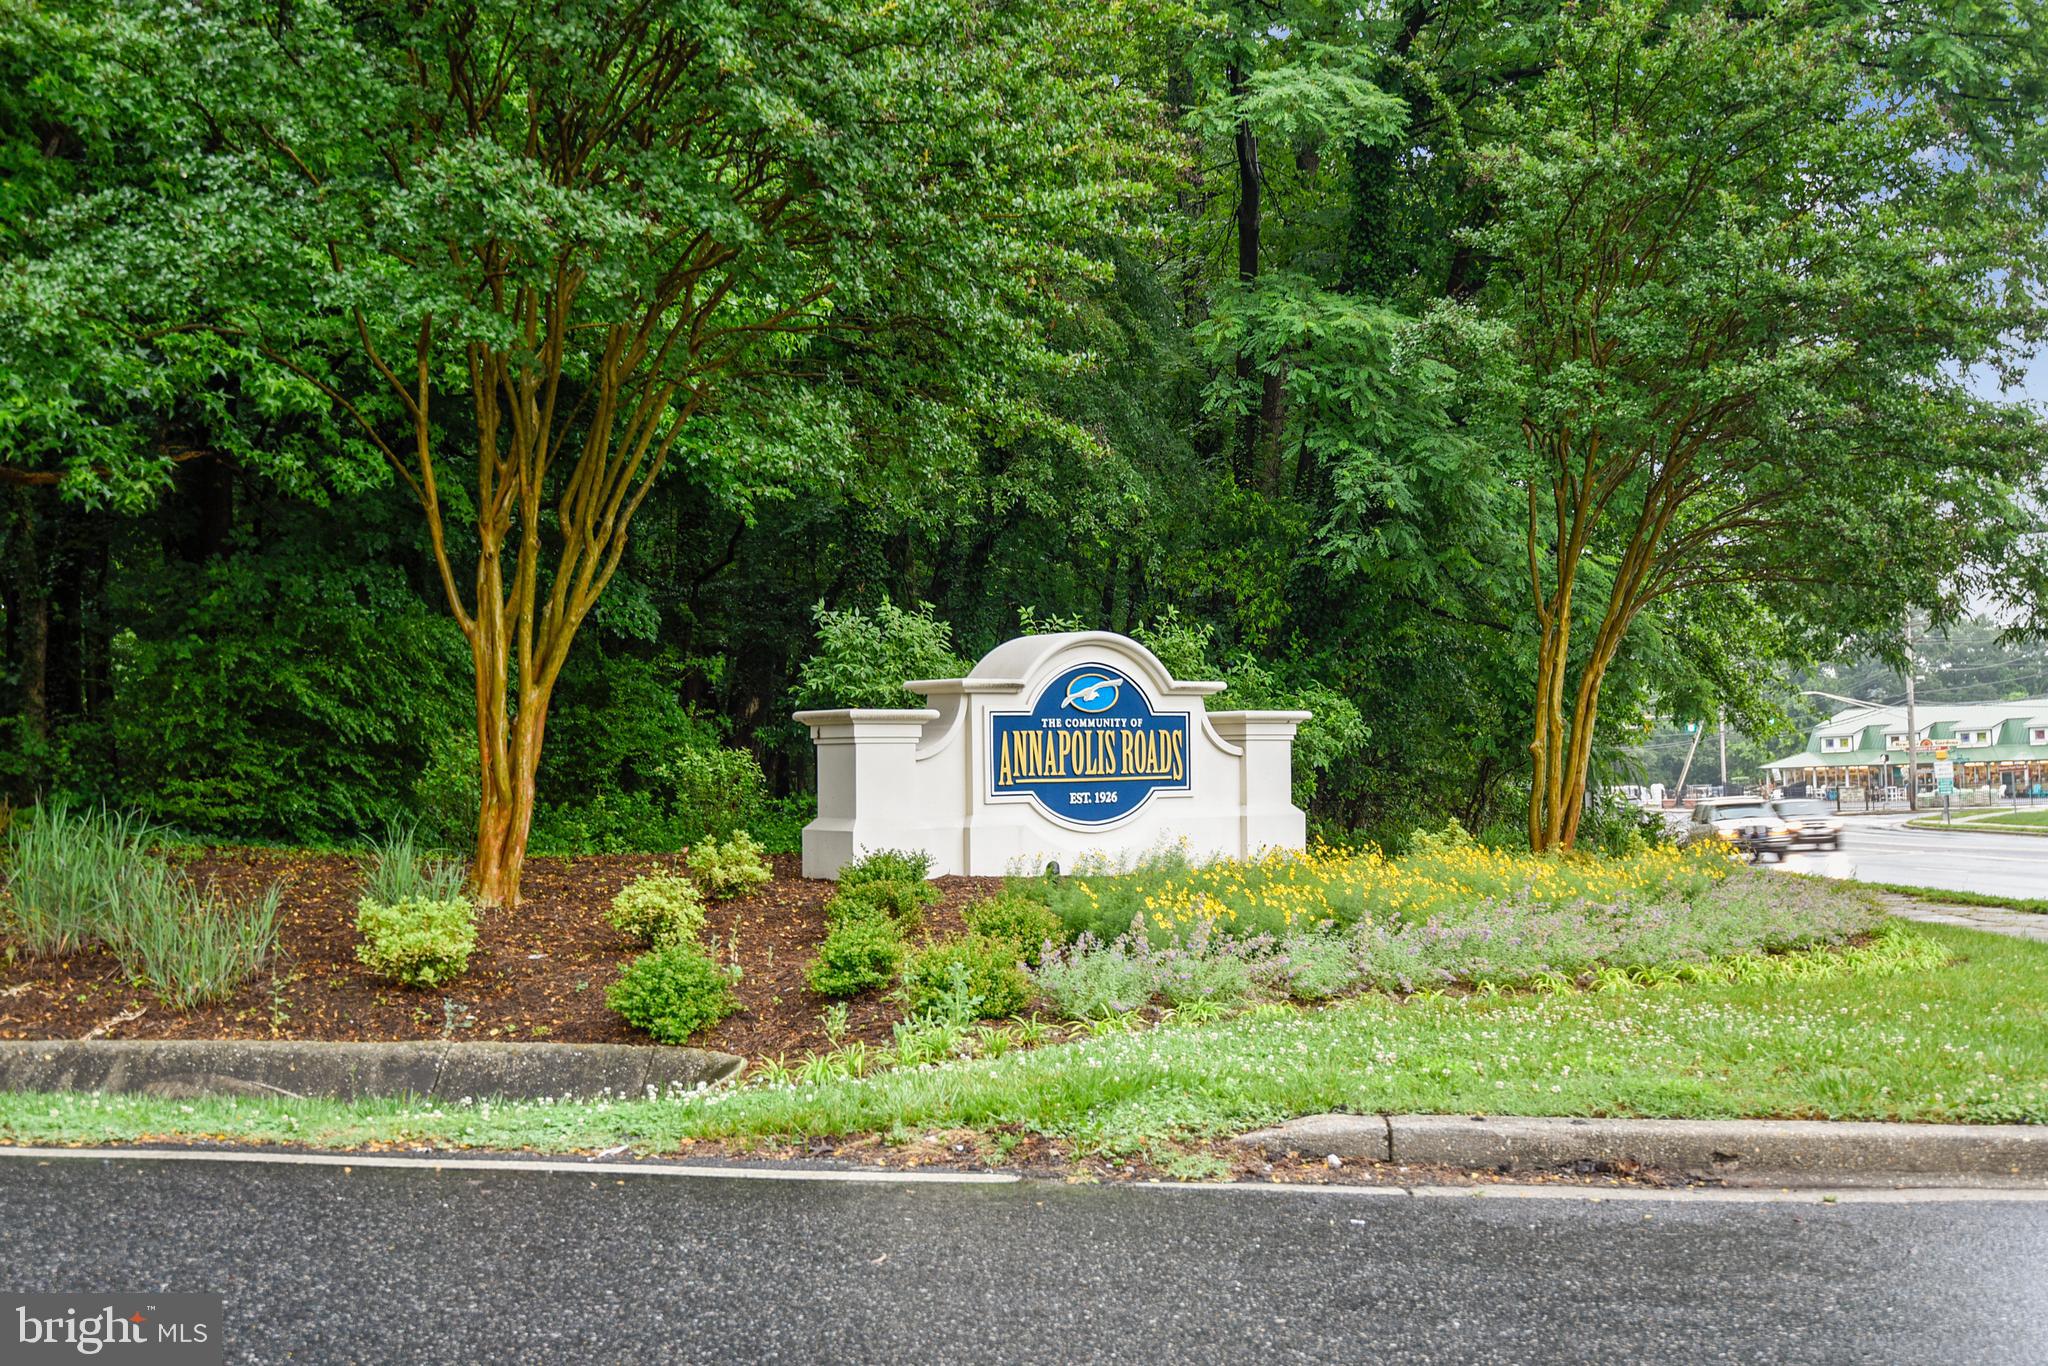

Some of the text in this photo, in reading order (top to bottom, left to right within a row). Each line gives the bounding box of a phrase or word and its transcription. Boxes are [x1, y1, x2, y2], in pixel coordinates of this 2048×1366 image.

[1041, 718, 1143, 728] THE COMMUNITY OF
[998, 729, 1183, 786] ANNAPOLIS ROADS
[1069, 791, 1118, 804] EST. 1926
